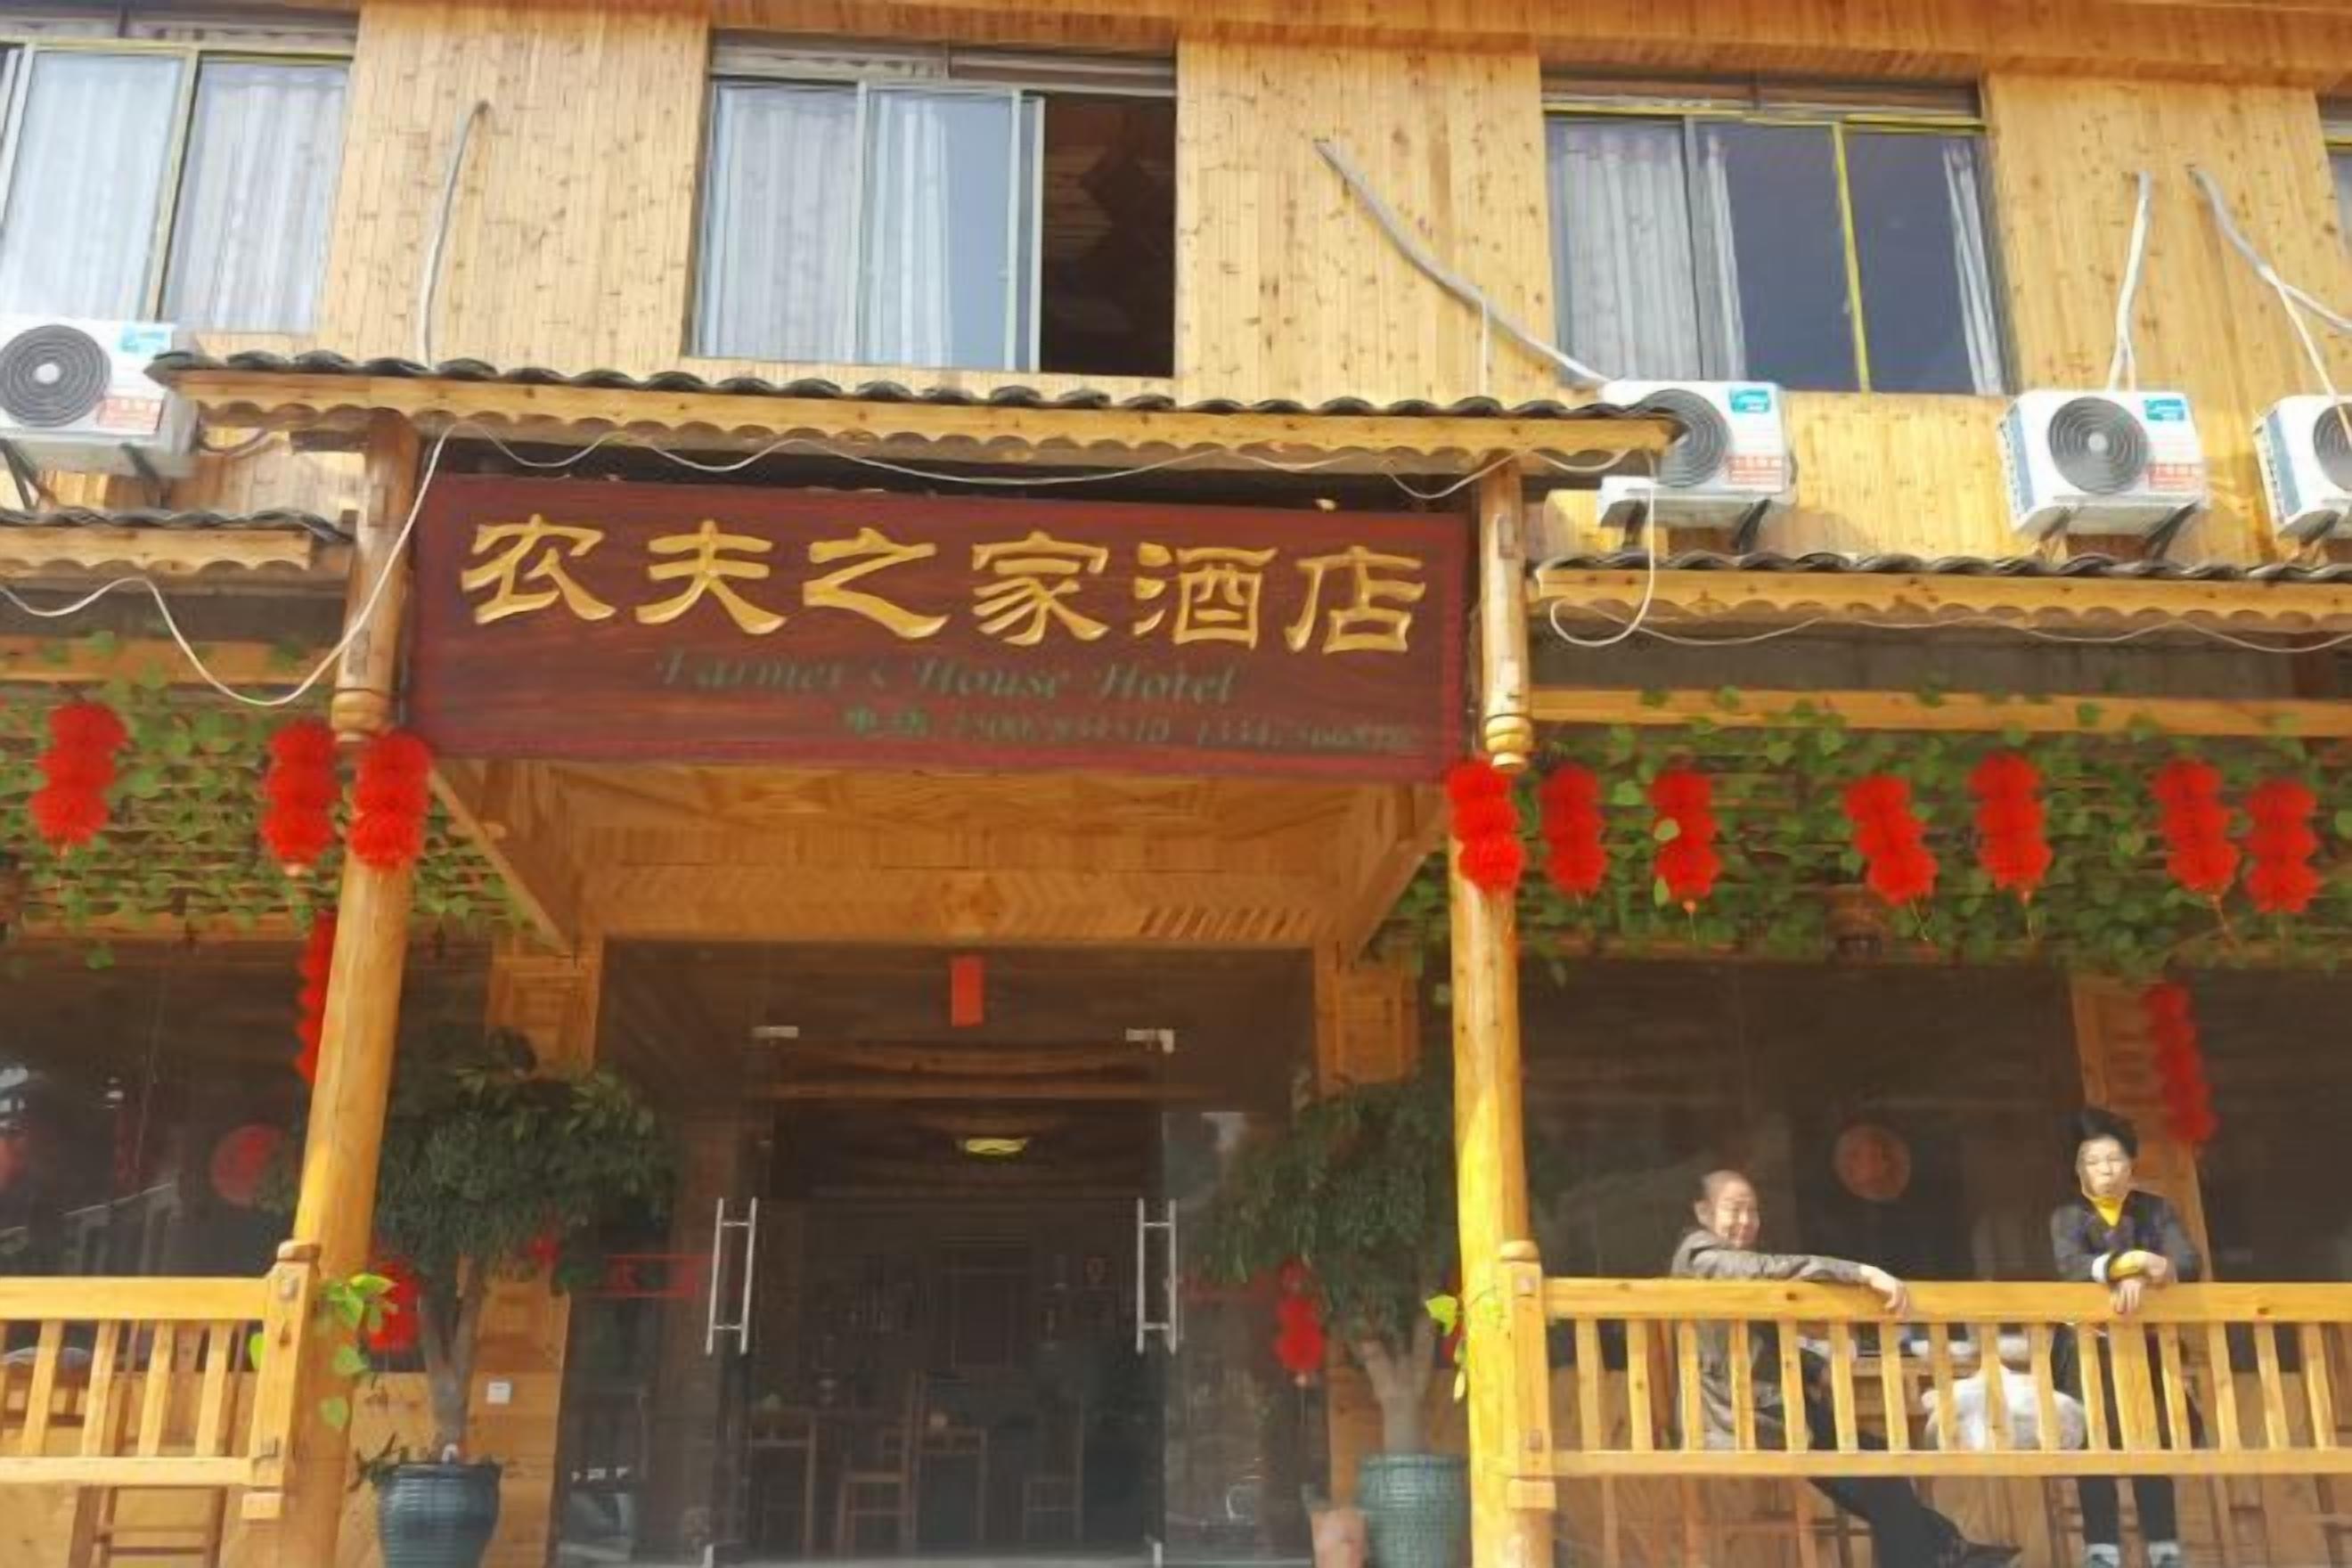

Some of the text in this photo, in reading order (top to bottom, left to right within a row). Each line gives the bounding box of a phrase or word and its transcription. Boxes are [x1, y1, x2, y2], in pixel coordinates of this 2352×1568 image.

[460, 512, 1425, 656] 农夫之家酒店
[912, 658, 1072, 701] House
[1094, 662, 1235, 710] Hotel
